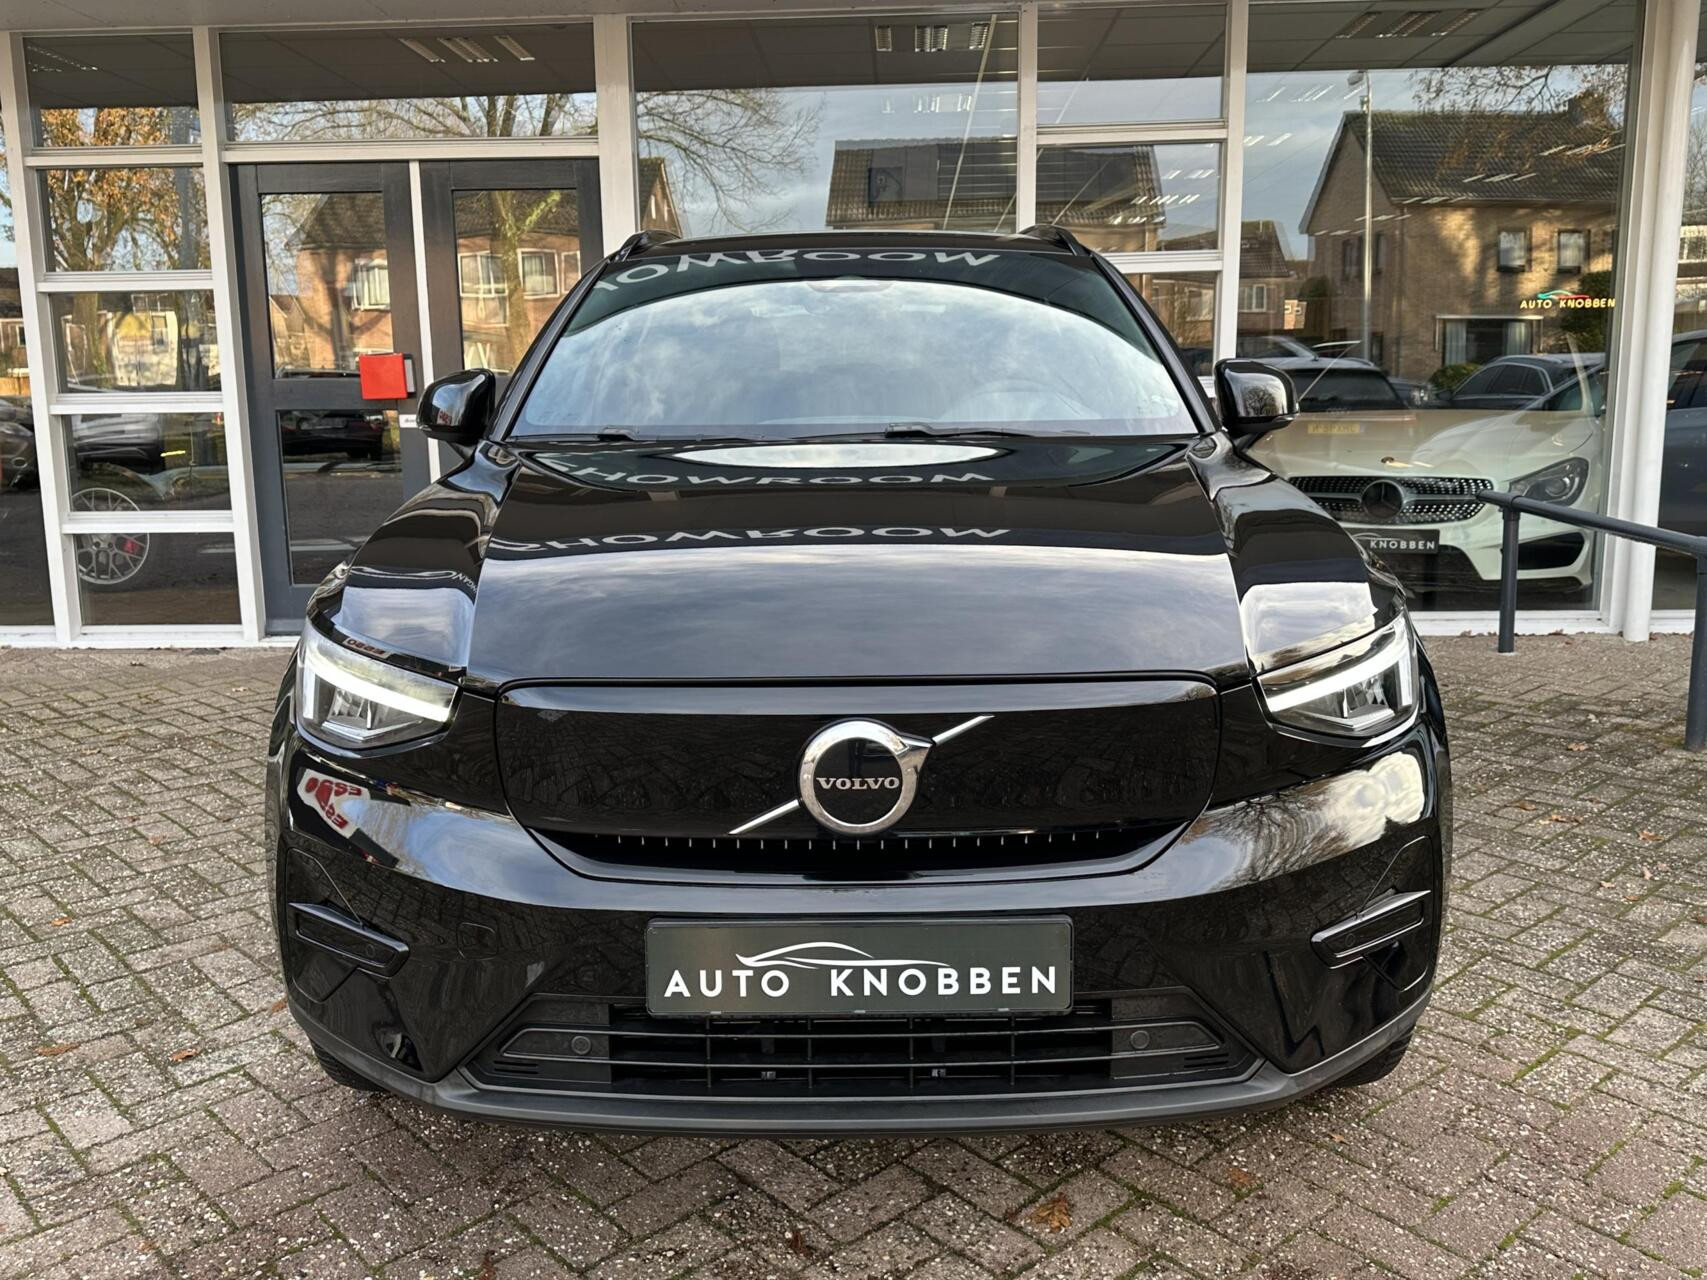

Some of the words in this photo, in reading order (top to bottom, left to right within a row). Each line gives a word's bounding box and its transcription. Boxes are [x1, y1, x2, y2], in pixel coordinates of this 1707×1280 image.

[1520, 299, 1552, 309] AUTO
[1559, 298, 1616, 308] KNOBBEN
[1370, 540, 1435, 550] KNOBBEN
[815, 776, 901, 791] VOLVO
[664, 969, 790, 998] AUTO
[831, 966, 1057, 996] KNOBBEN
